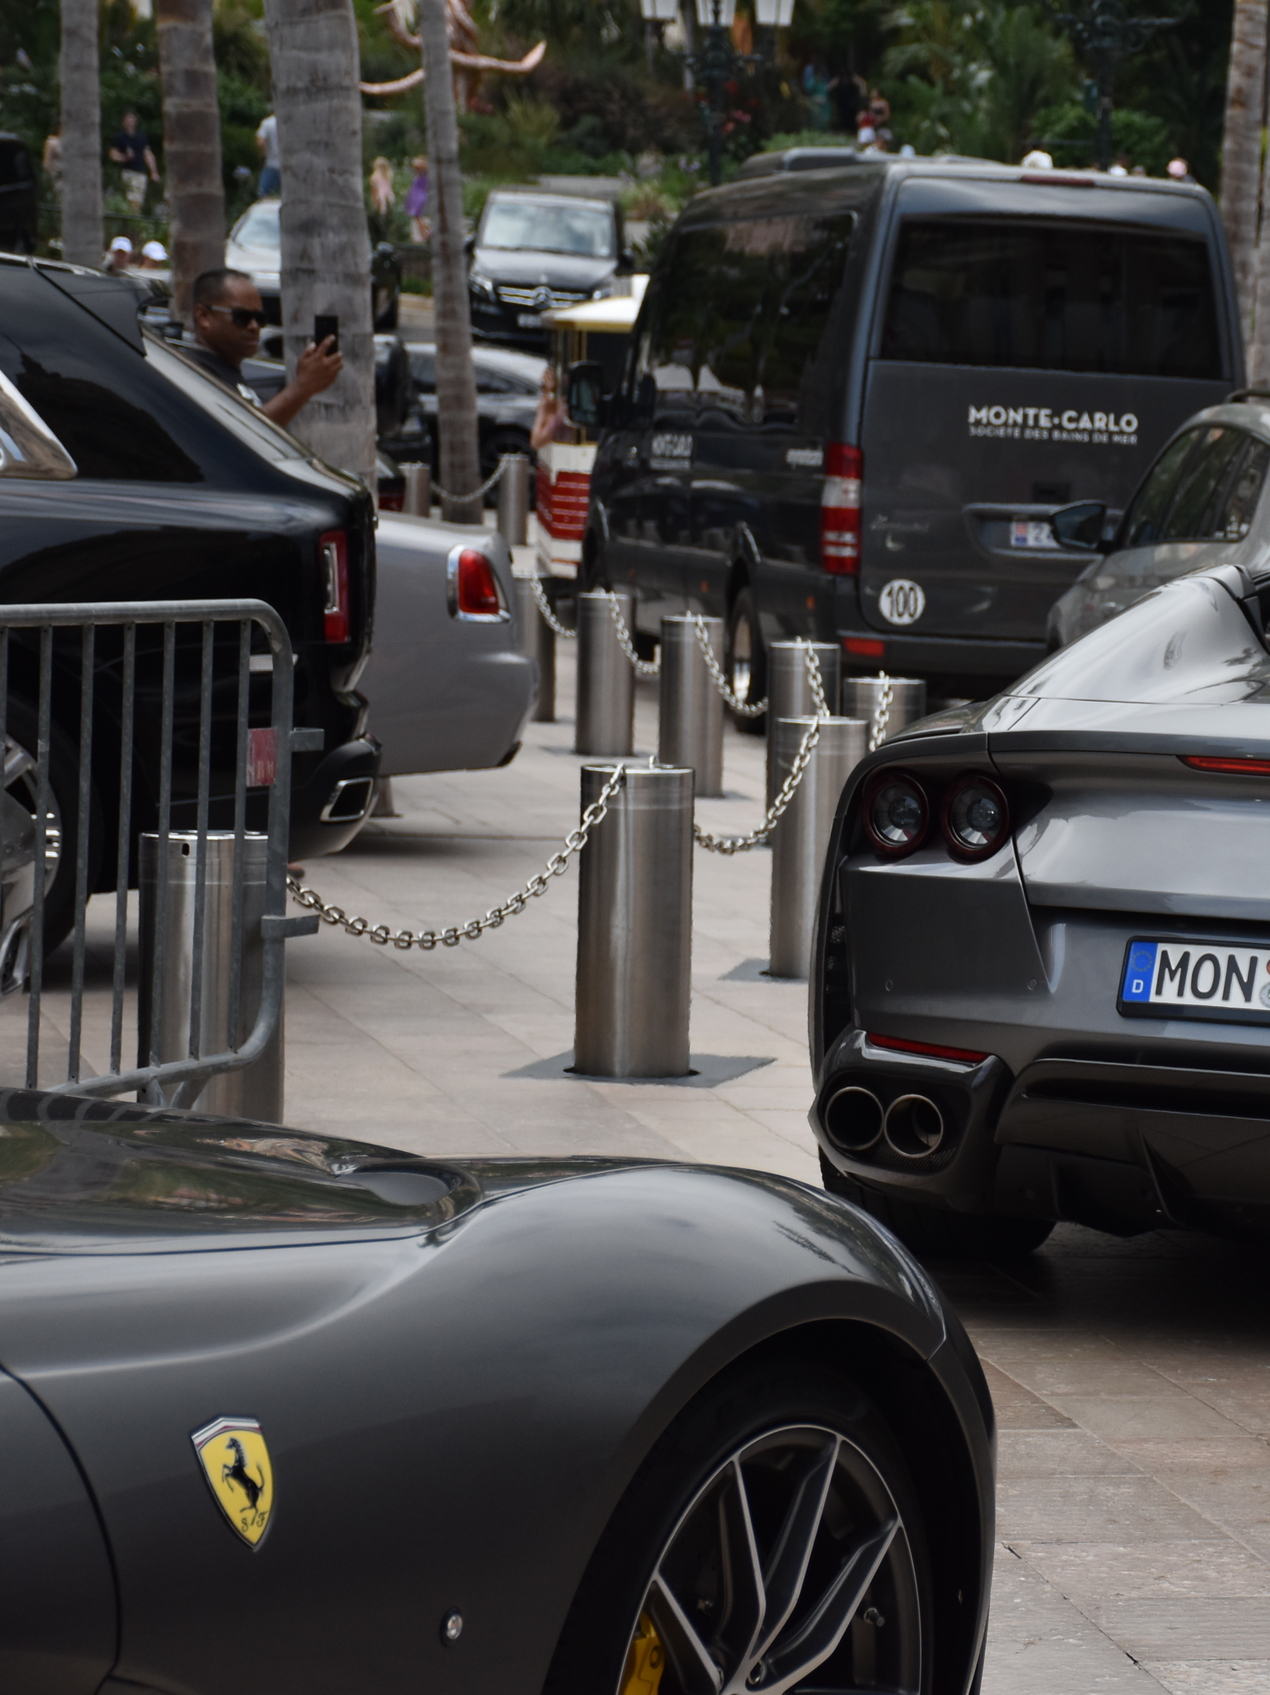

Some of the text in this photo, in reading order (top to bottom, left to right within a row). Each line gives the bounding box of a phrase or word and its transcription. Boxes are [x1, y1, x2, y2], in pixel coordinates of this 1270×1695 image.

[887, 586, 918, 618] 100
[1131, 979, 1144, 994] D
[1155, 949, 1258, 1003] MON
